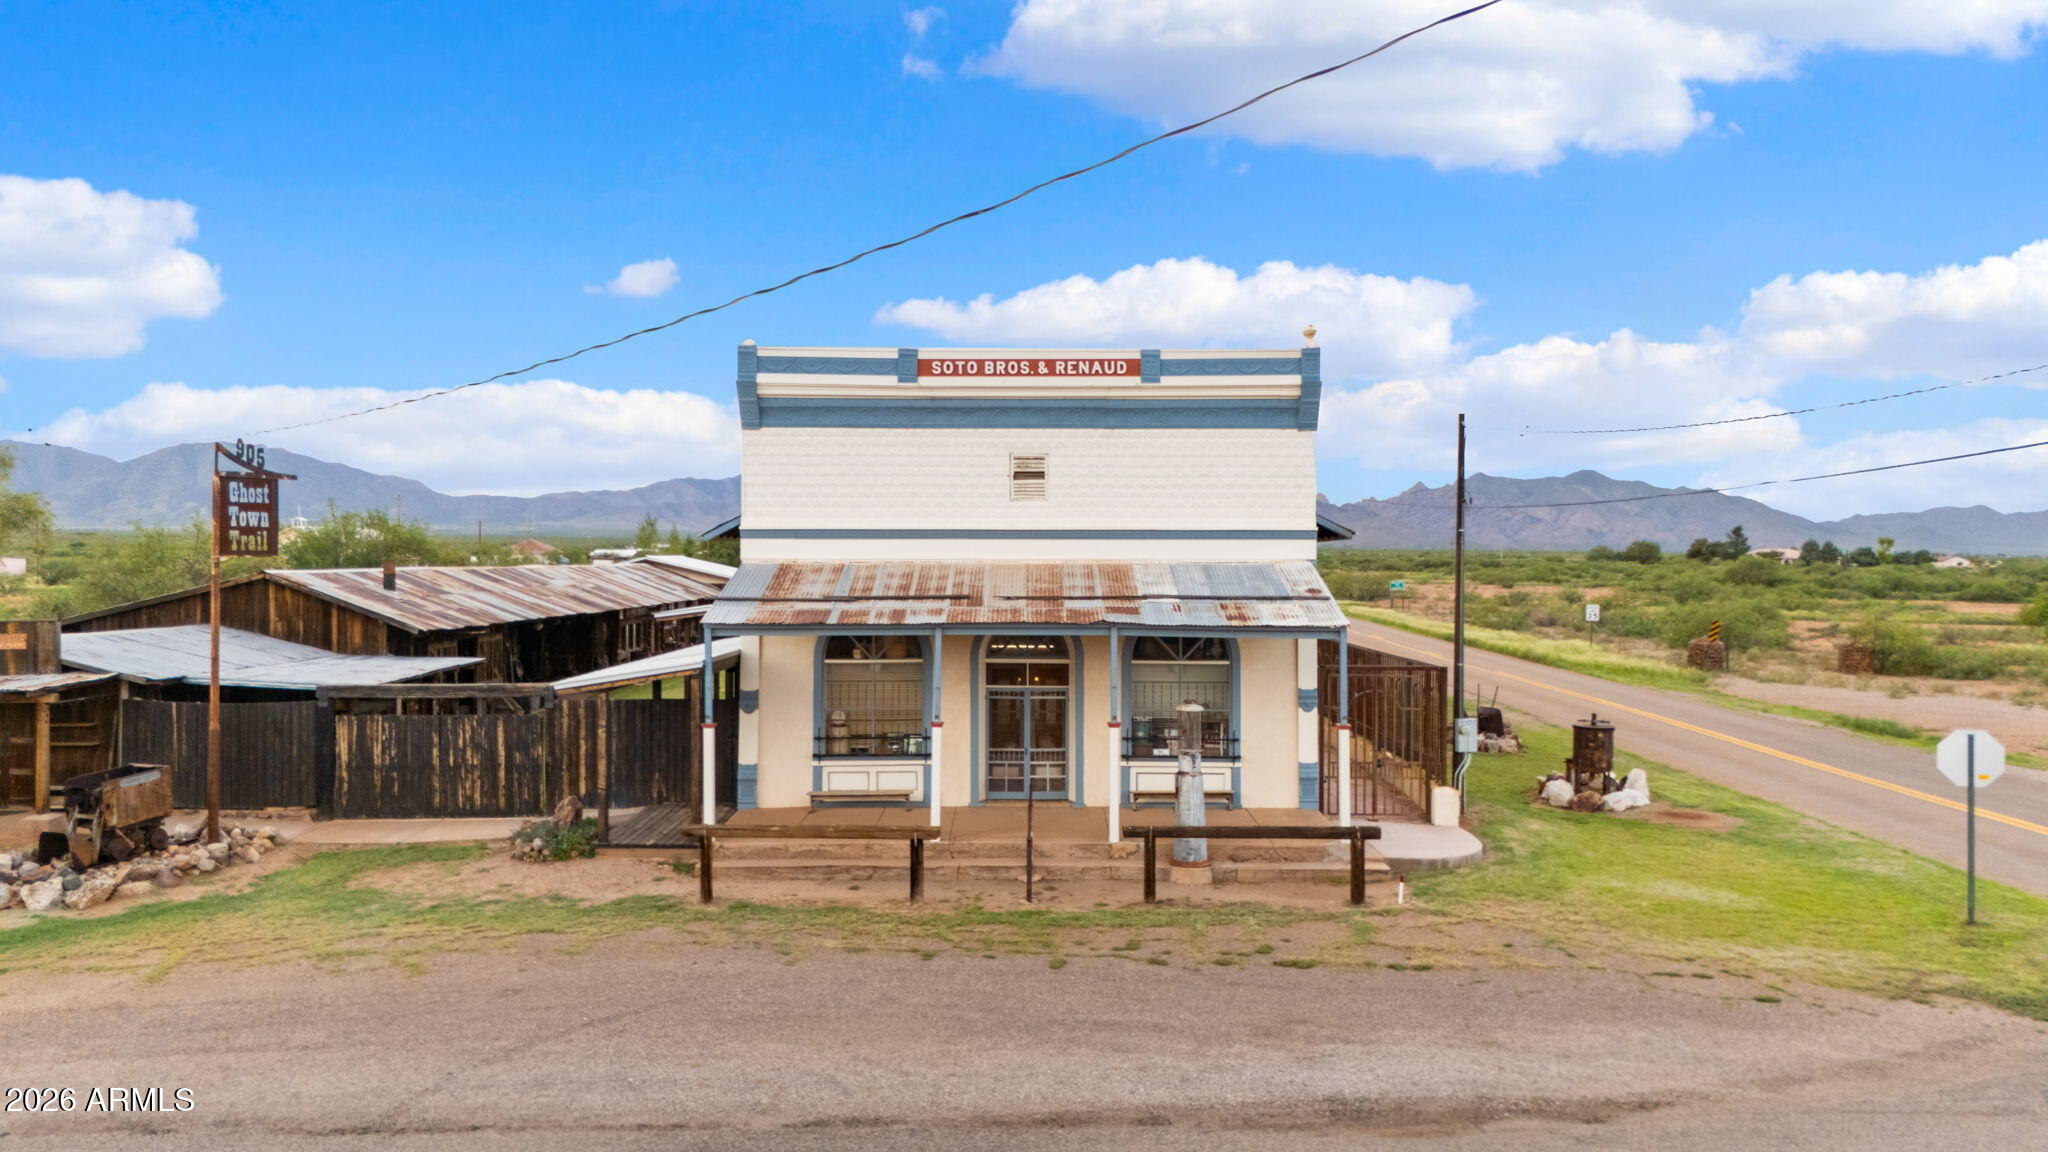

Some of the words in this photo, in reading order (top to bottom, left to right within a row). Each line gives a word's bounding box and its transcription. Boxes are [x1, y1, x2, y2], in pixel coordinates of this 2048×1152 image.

[931, 361, 978, 374] SOTO
[984, 361, 1034, 374] BROS.
[1038, 361, 1049, 374] &
[1055, 361, 1127, 374] RENAUD
[236, 438, 265, 469] 905
[229, 481, 269, 504] Ghost
[228, 506, 269, 528] Town
[229, 530, 268, 551] Trail
